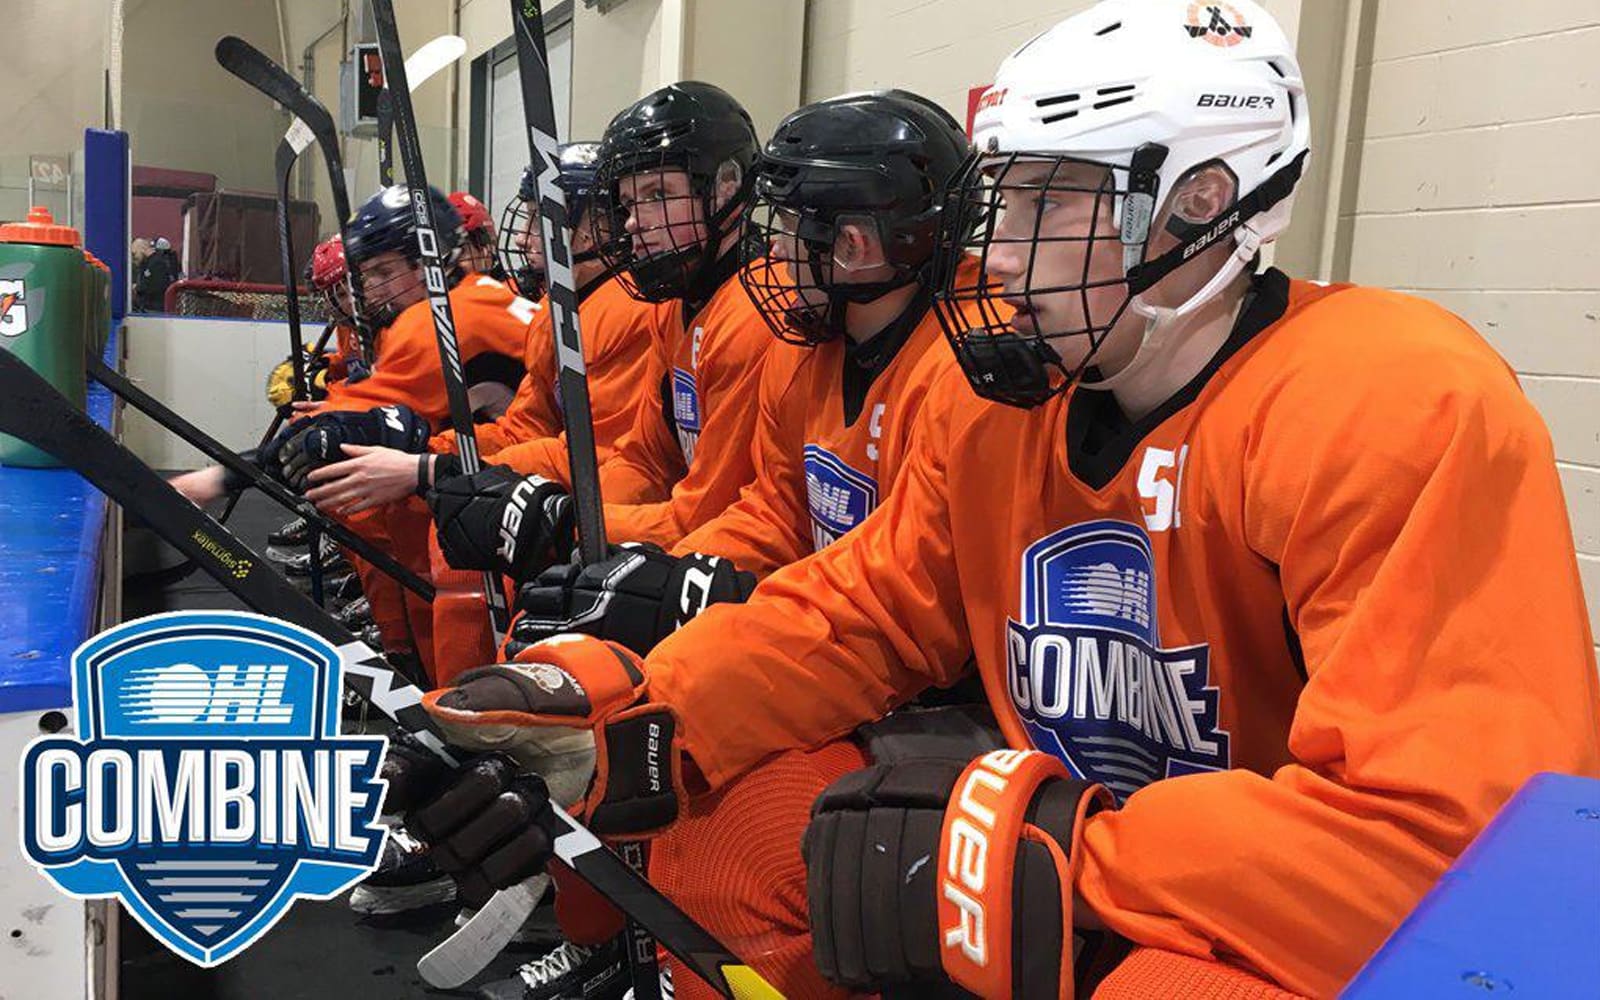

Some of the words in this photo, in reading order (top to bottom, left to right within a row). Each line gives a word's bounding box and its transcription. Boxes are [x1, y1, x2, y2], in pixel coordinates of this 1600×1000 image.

[1196, 93, 1276, 110] BAUER
[531, 126, 587, 376] CCM
[1183, 211, 1241, 260] BAUER
[1137, 444, 1189, 531] 5
[1008, 627, 1218, 756] COMBINE
[648, 723, 660, 791] BAUER
